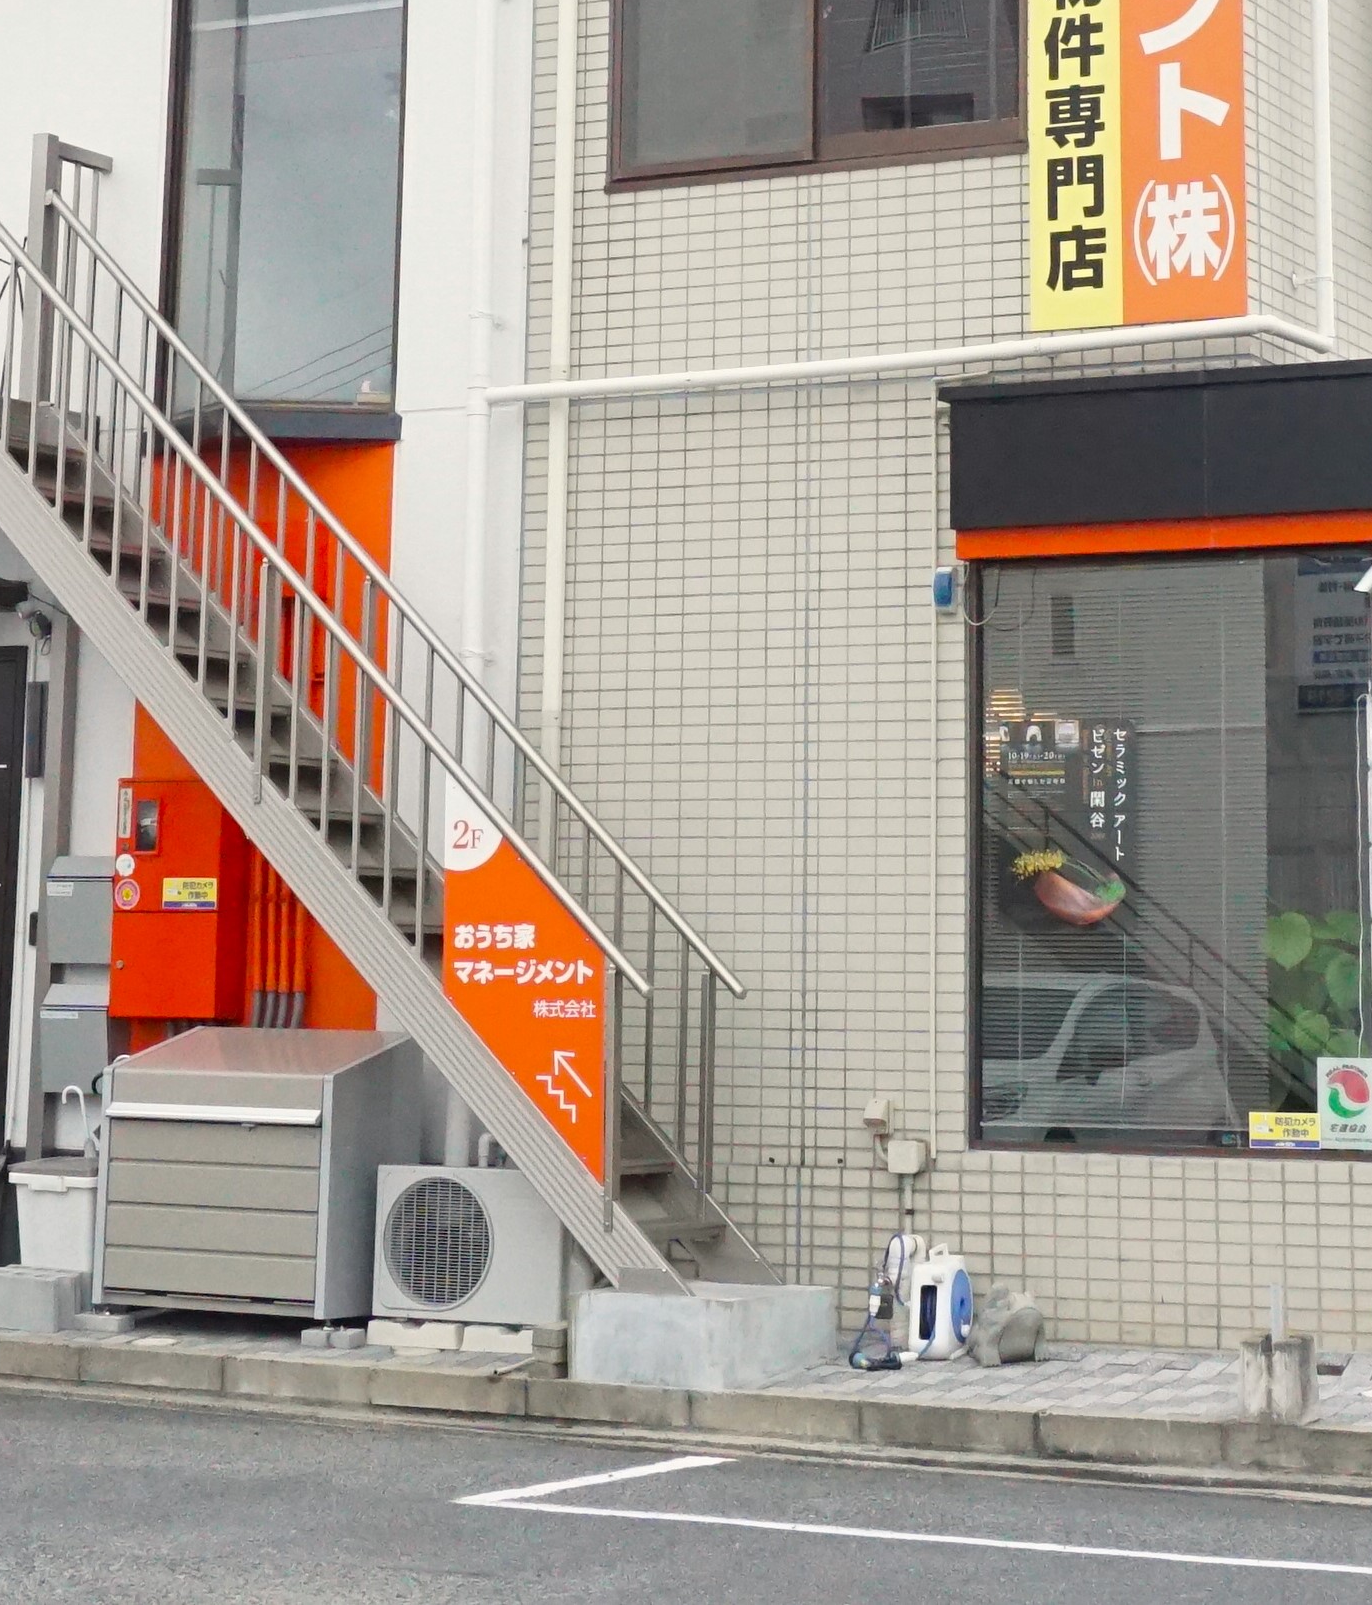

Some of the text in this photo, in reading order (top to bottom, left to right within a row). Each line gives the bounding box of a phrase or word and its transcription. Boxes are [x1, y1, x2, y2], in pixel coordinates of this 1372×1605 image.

[1113, 728, 1127, 861] セラミック アート
[452, 820, 484, 849] 2F
[454, 924, 535, 950] おうち家
[453, 959, 594, 985] マネージメント
[533, 999, 597, 1019] 株式会社
